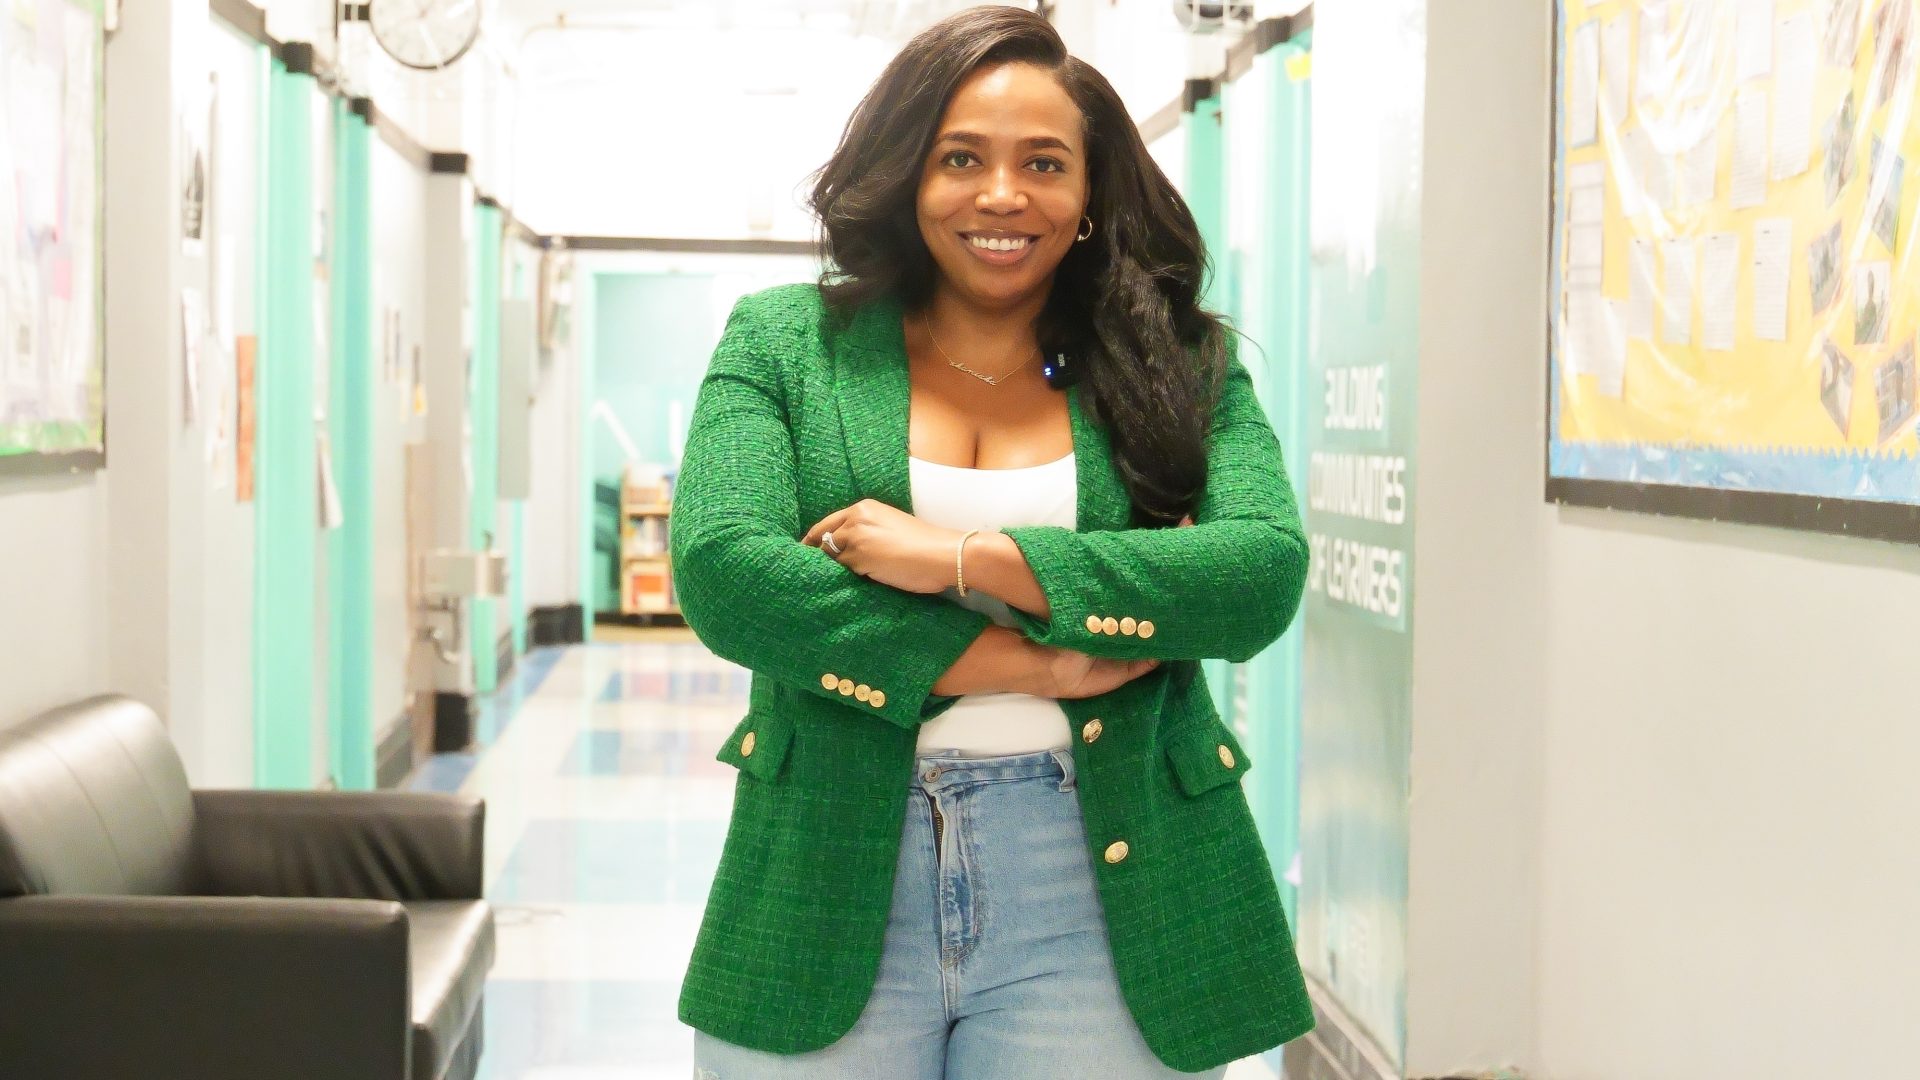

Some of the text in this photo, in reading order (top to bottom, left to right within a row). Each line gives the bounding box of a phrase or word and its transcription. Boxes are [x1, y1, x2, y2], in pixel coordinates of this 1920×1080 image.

[1324, 365, 1384, 431] BUILDING
[1311, 452, 1405, 525] COMMUNITIES
[1327, 536, 1402, 617] LEARNERS
